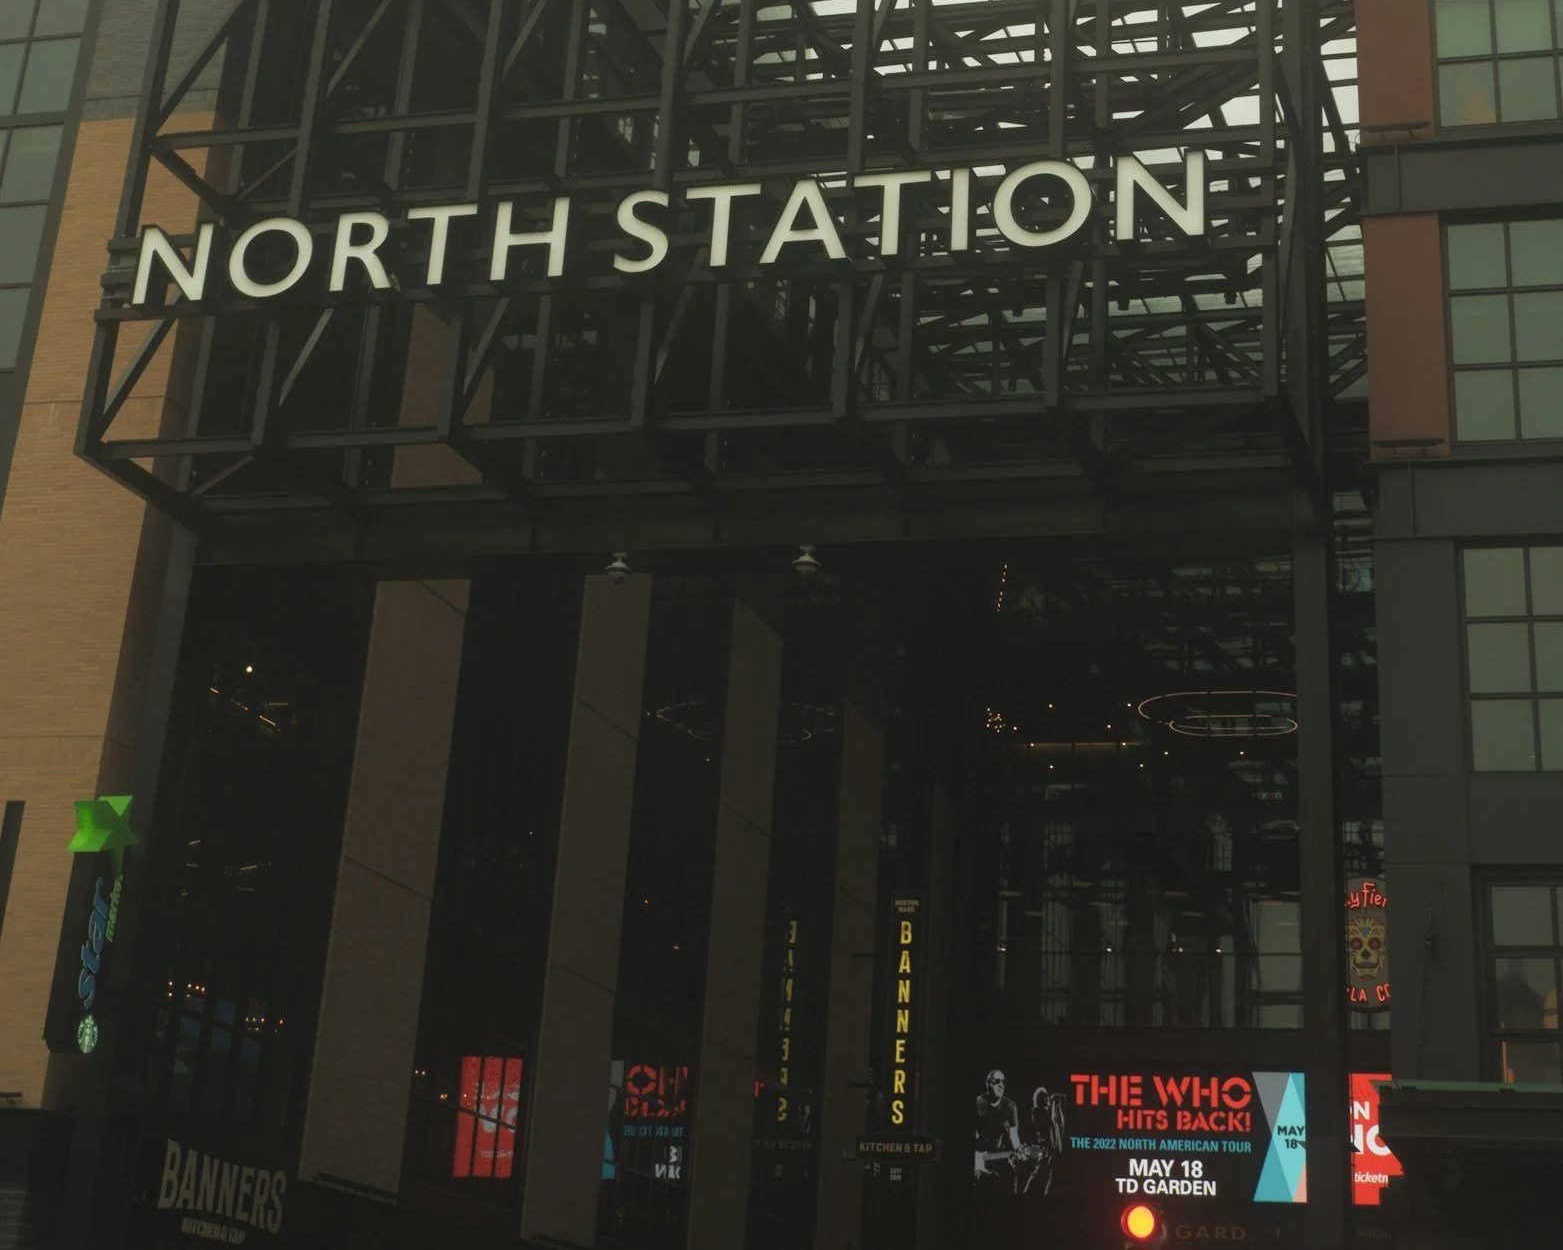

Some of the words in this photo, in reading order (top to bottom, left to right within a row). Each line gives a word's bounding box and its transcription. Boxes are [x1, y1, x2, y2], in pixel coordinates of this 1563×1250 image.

[132, 196, 570, 305] NORTH
[614, 150, 1205, 273] STATION
[78, 876, 108, 1010] star
[891, 920, 913, 1125] BANNERS
[1071, 1074, 1142, 1106] THE
[1153, 1076, 1251, 1109] WHO
[1117, 1109, 1169, 1130] HITS
[1176, 1110, 1251, 1132] BACK!
[1277, 1125, 1304, 1136] MAY
[859, 1141, 903, 1153] KITCHEN
[913, 1144, 933, 1154] TAP
[1071, 1137, 1091, 1149] THE
[1093, 1138, 1116, 1149] 2022
[1119, 1138, 1156, 1150] NORTH
[1160, 1140, 1219, 1152] AMERICAN
[1221, 1141, 1251, 1153] TOUR
[1284, 1138, 1299, 1149] 18
[1129, 1158, 1175, 1177] MAY
[1180, 1160, 1203, 1179] 18
[157, 1138, 287, 1234] BANNERS
[1115, 1178, 1139, 1193] TD
[1142, 1178, 1217, 1196] GARDEN
[1174, 1223, 1281, 1241] GARD
